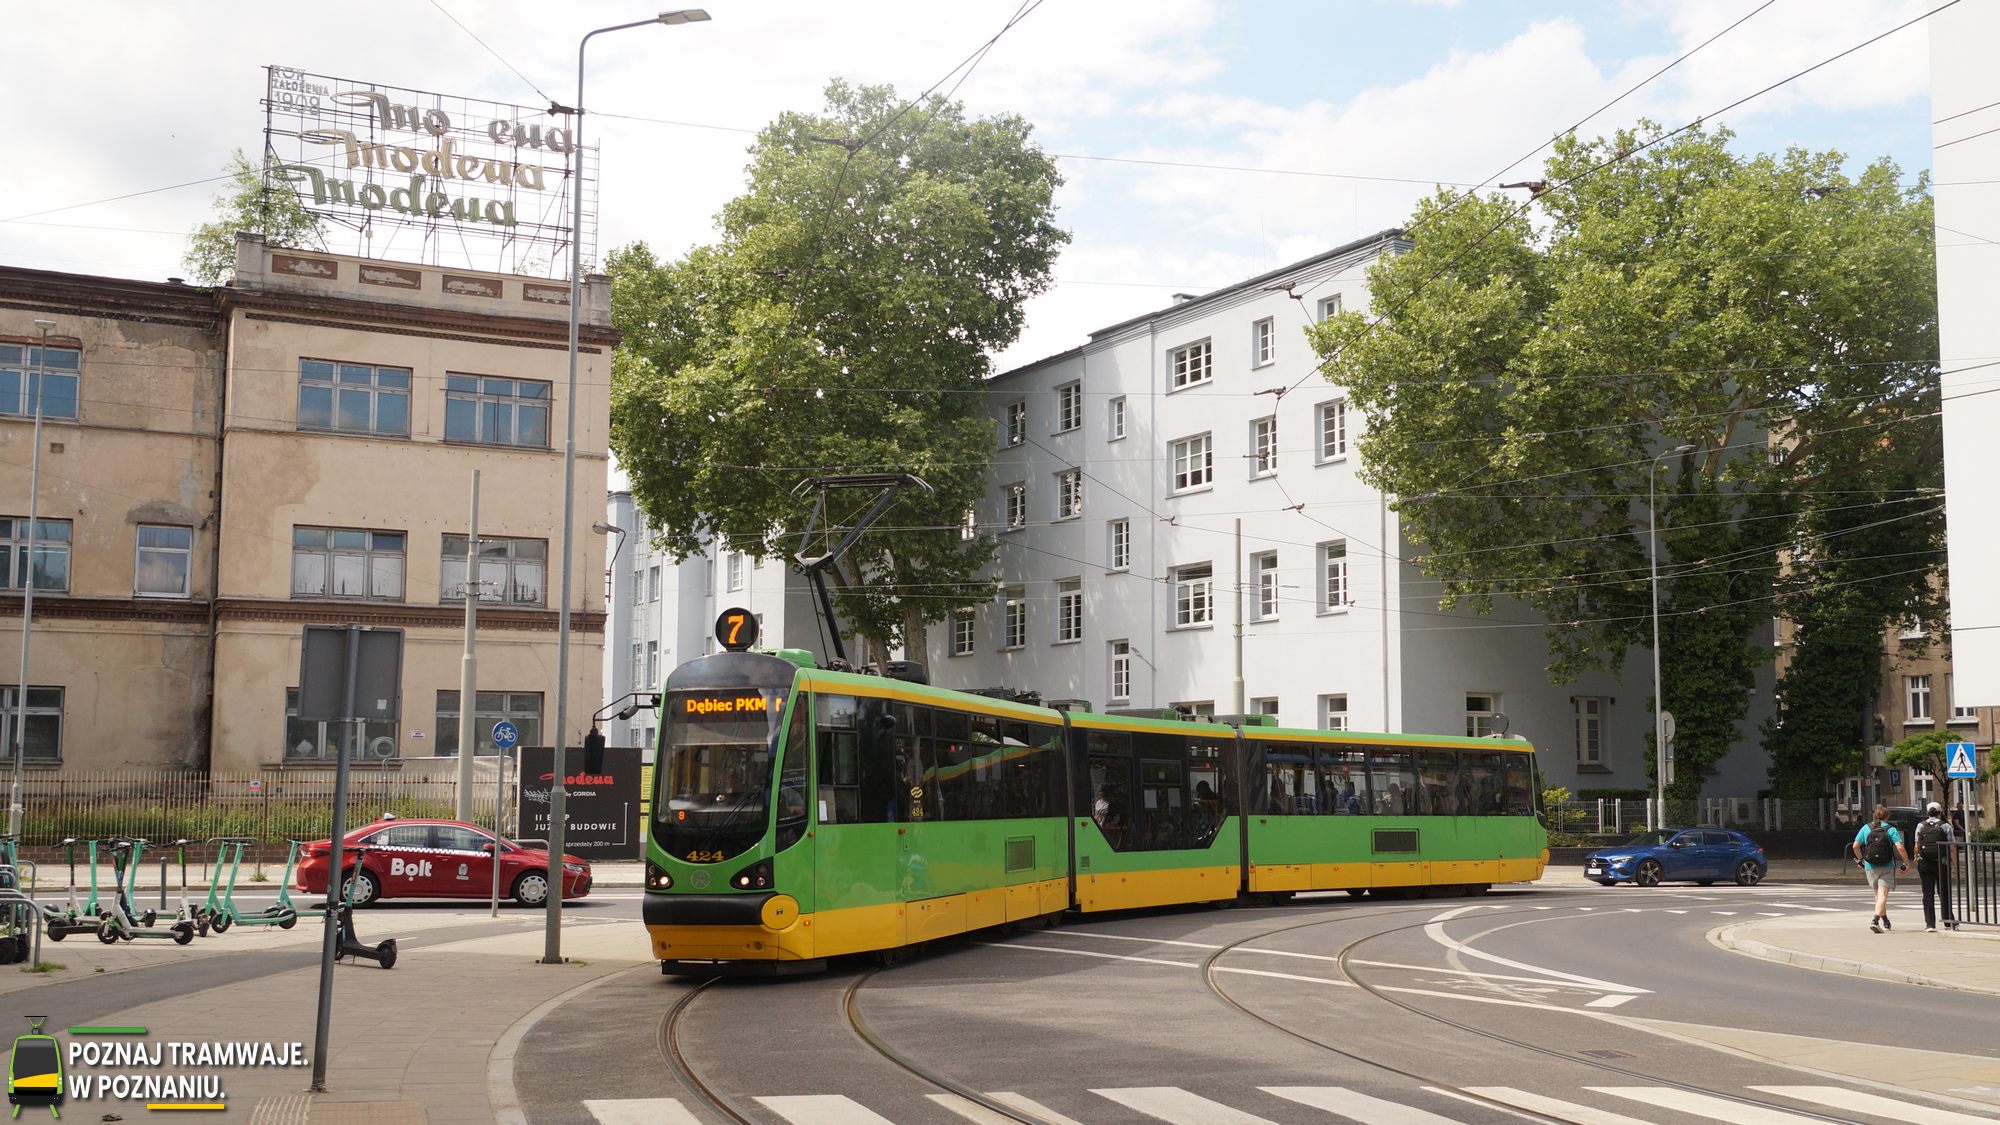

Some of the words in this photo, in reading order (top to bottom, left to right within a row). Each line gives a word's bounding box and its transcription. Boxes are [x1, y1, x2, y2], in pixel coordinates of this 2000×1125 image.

[728, 614, 744, 644] 7
[686, 699, 733, 714] Dębiec
[736, 698, 767, 711] PKM
[686, 850, 725, 861] 424
[390, 858, 432, 881] Bolt
